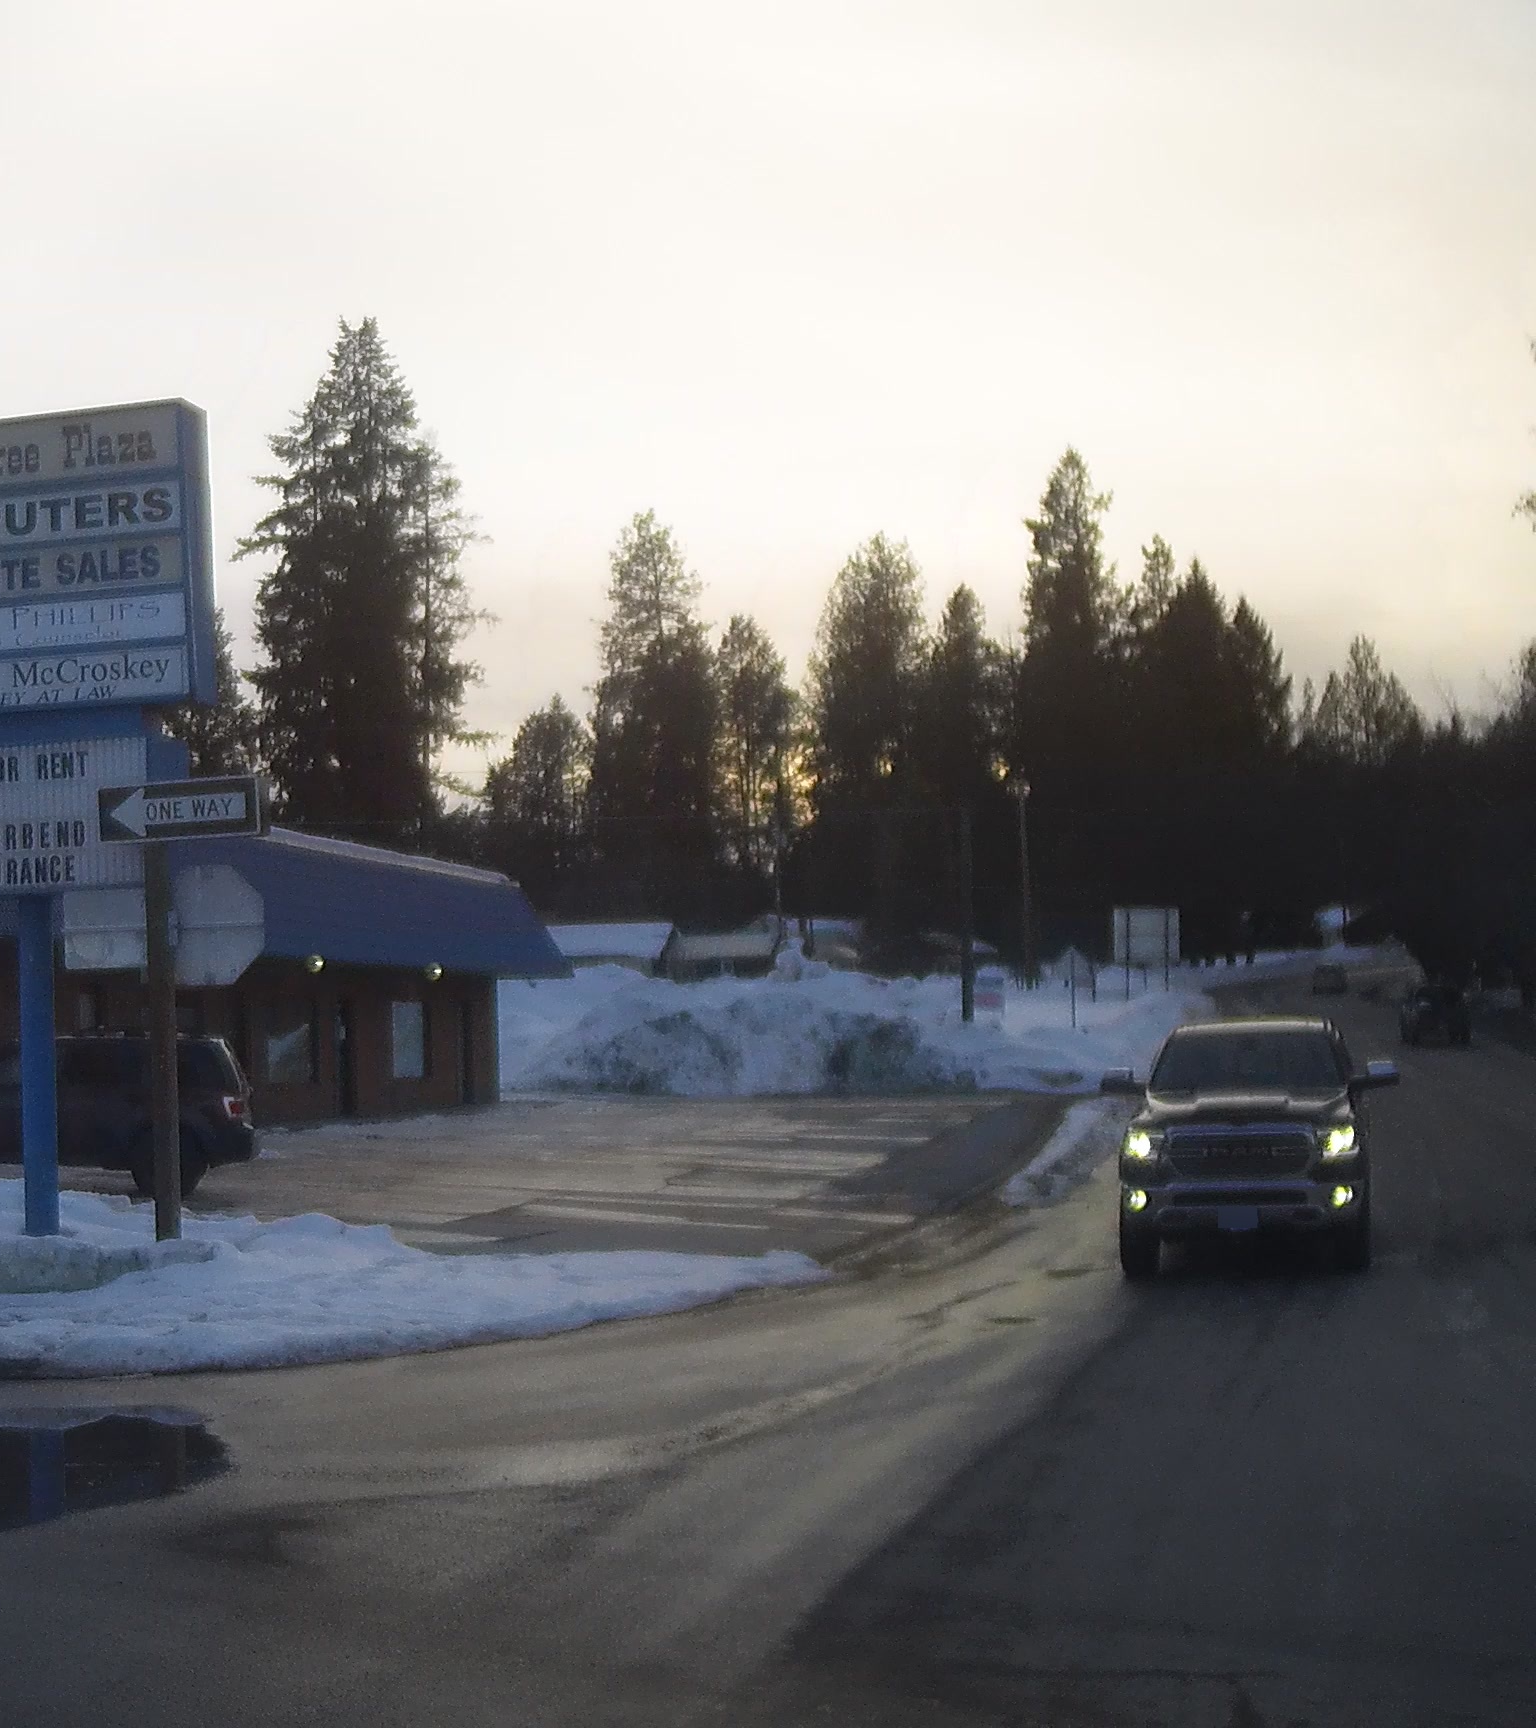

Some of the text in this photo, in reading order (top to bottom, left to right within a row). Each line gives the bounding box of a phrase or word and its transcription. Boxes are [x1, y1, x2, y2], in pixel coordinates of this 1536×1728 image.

[63, 423, 157, 468] Plaza
[56, 545, 161, 586] SALES
[12, 600, 161, 630] PHILLIPS
[12, 653, 170, 689] McCroskey
[38, 688, 64, 703] AT
[74, 684, 116, 701] LAW
[36, 750, 90, 781] RENT
[145, 794, 234, 822] ONE WAY
